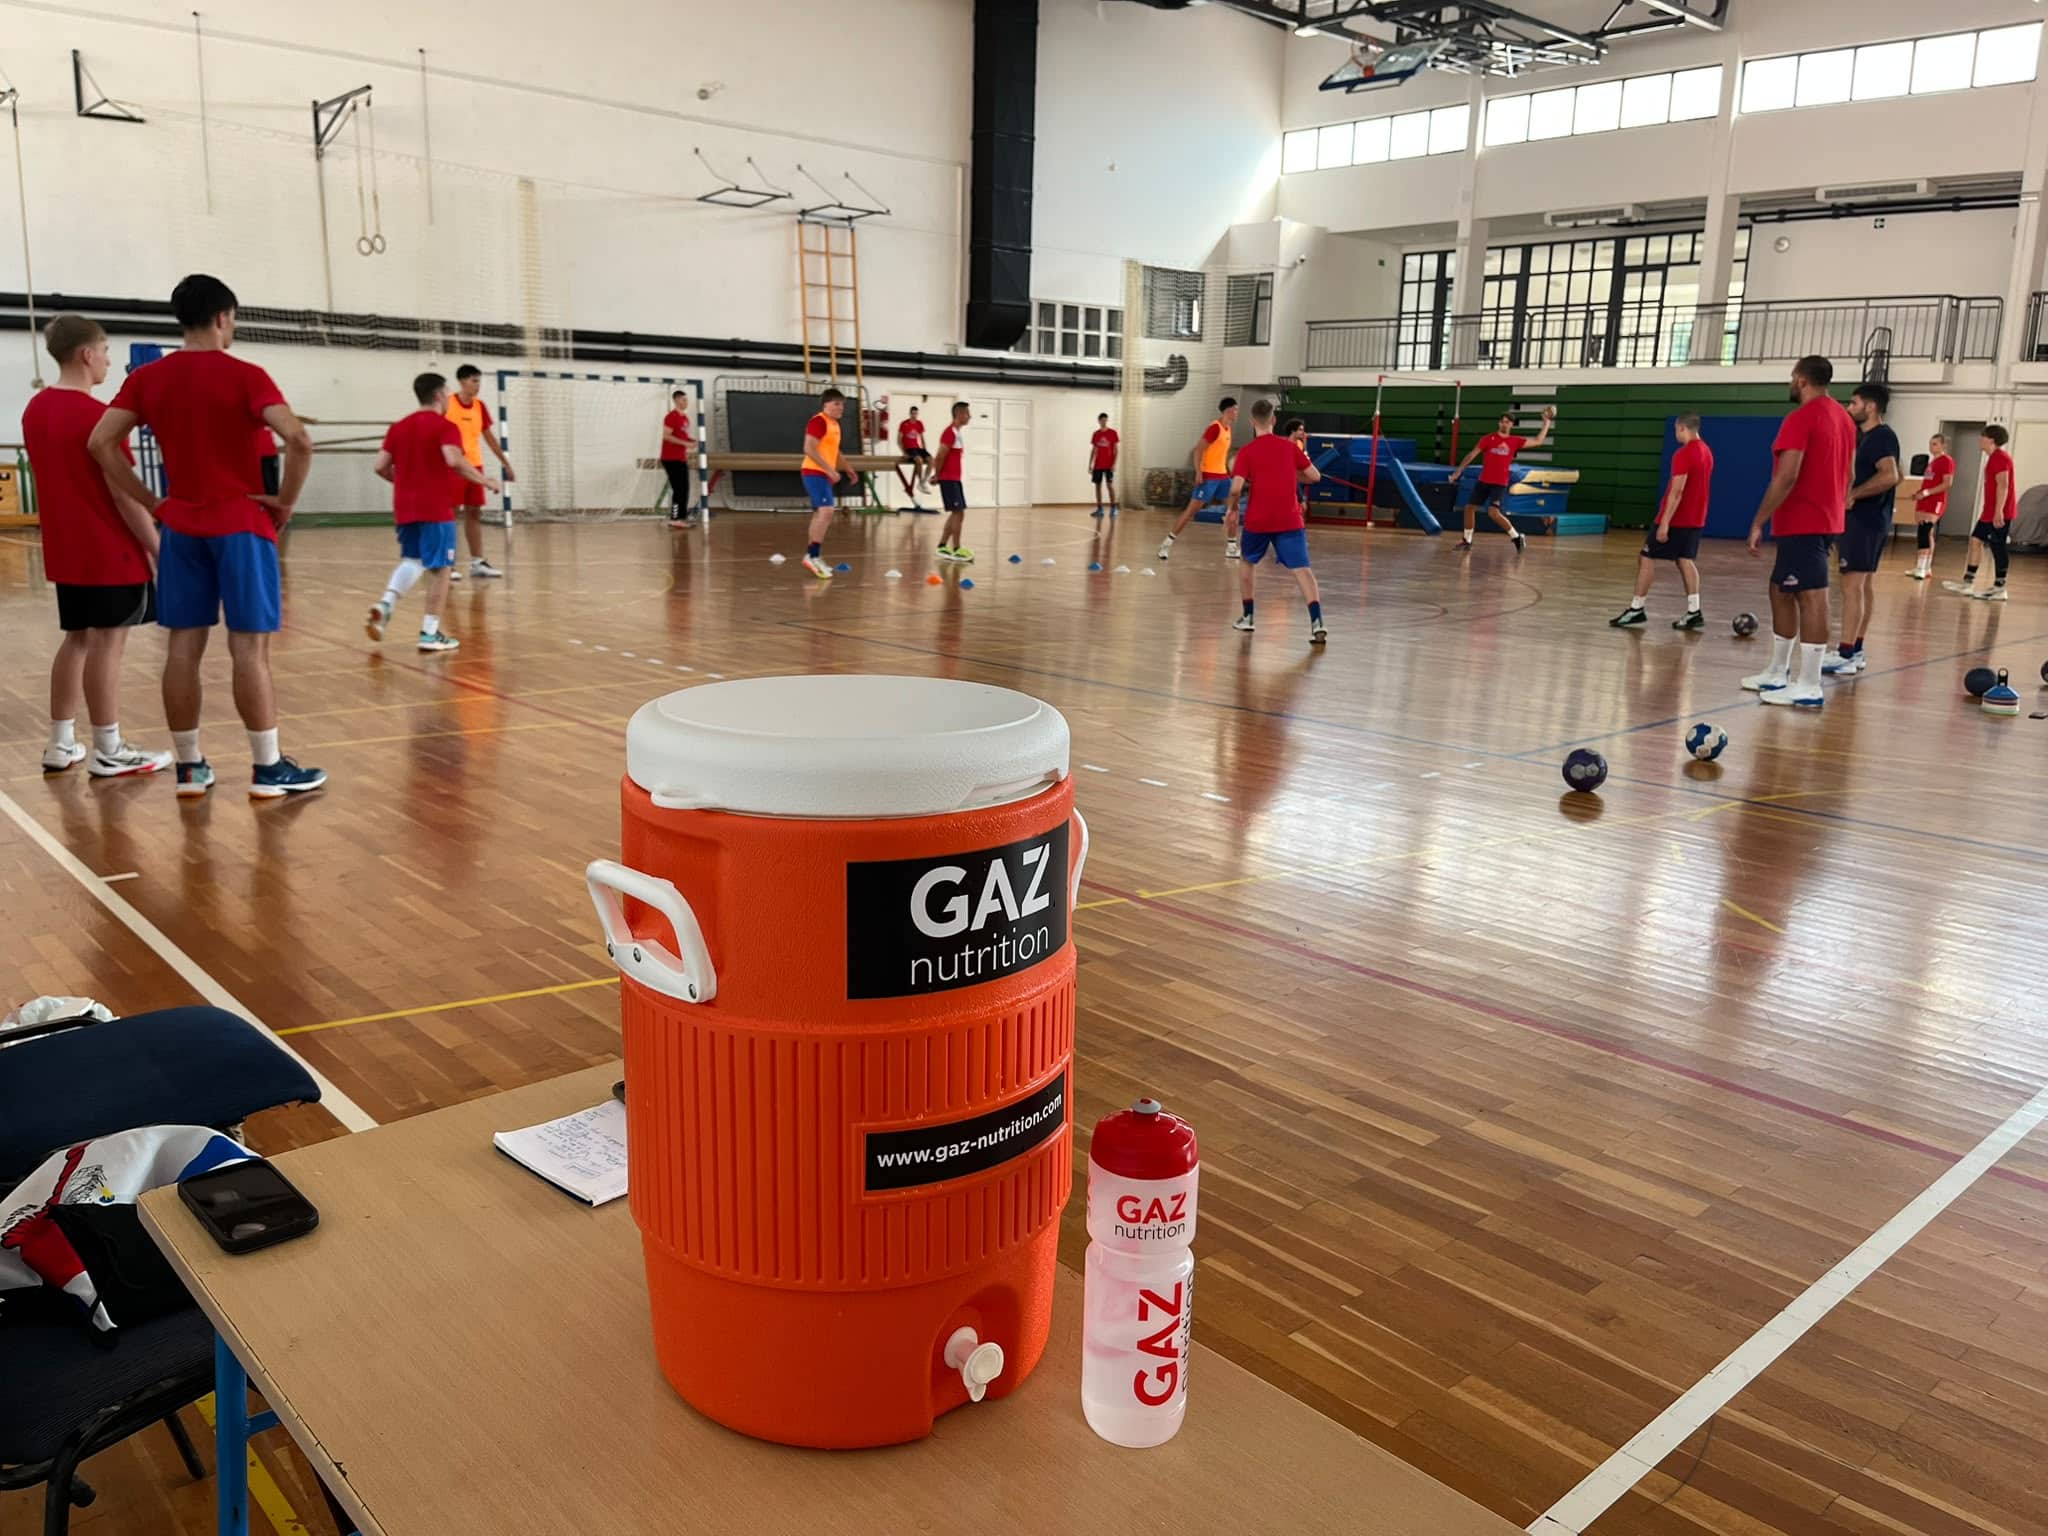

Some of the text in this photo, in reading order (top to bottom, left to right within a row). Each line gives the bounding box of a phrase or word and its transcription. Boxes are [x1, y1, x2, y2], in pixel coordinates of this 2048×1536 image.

[911, 842, 1050, 938] GAZ
[911, 925, 1049, 985] nutrition
[877, 1093, 1062, 1168] www.gaz-nutrition.com
[1115, 1222, 1186, 1240] nutrition
[1116, 1192, 1187, 1224] GAZ
[1134, 1281, 1182, 1406] GAZ
